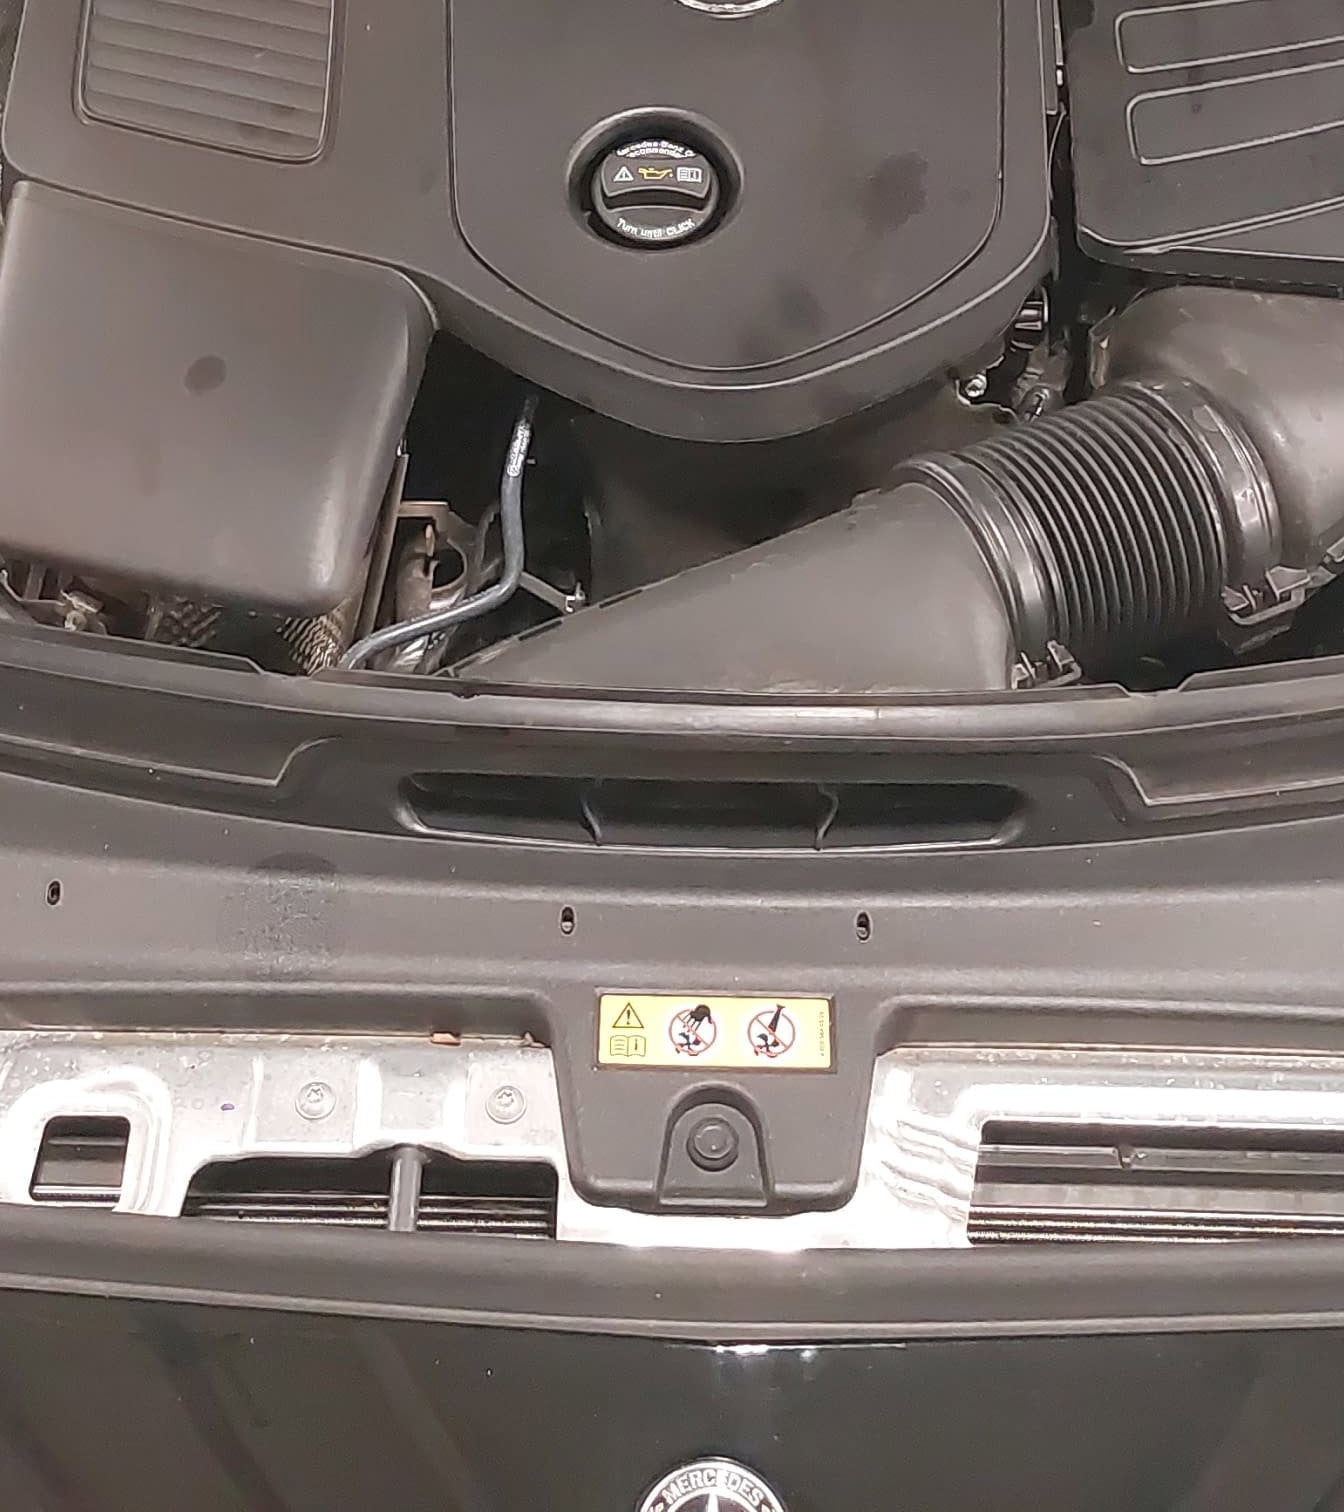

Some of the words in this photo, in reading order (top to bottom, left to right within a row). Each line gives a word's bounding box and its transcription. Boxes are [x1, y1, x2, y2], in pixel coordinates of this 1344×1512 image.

[616, 217, 638, 236] Turn
[666, 218, 696, 236] CLICK
[661, 1468, 765, 1506] MERCEDES
